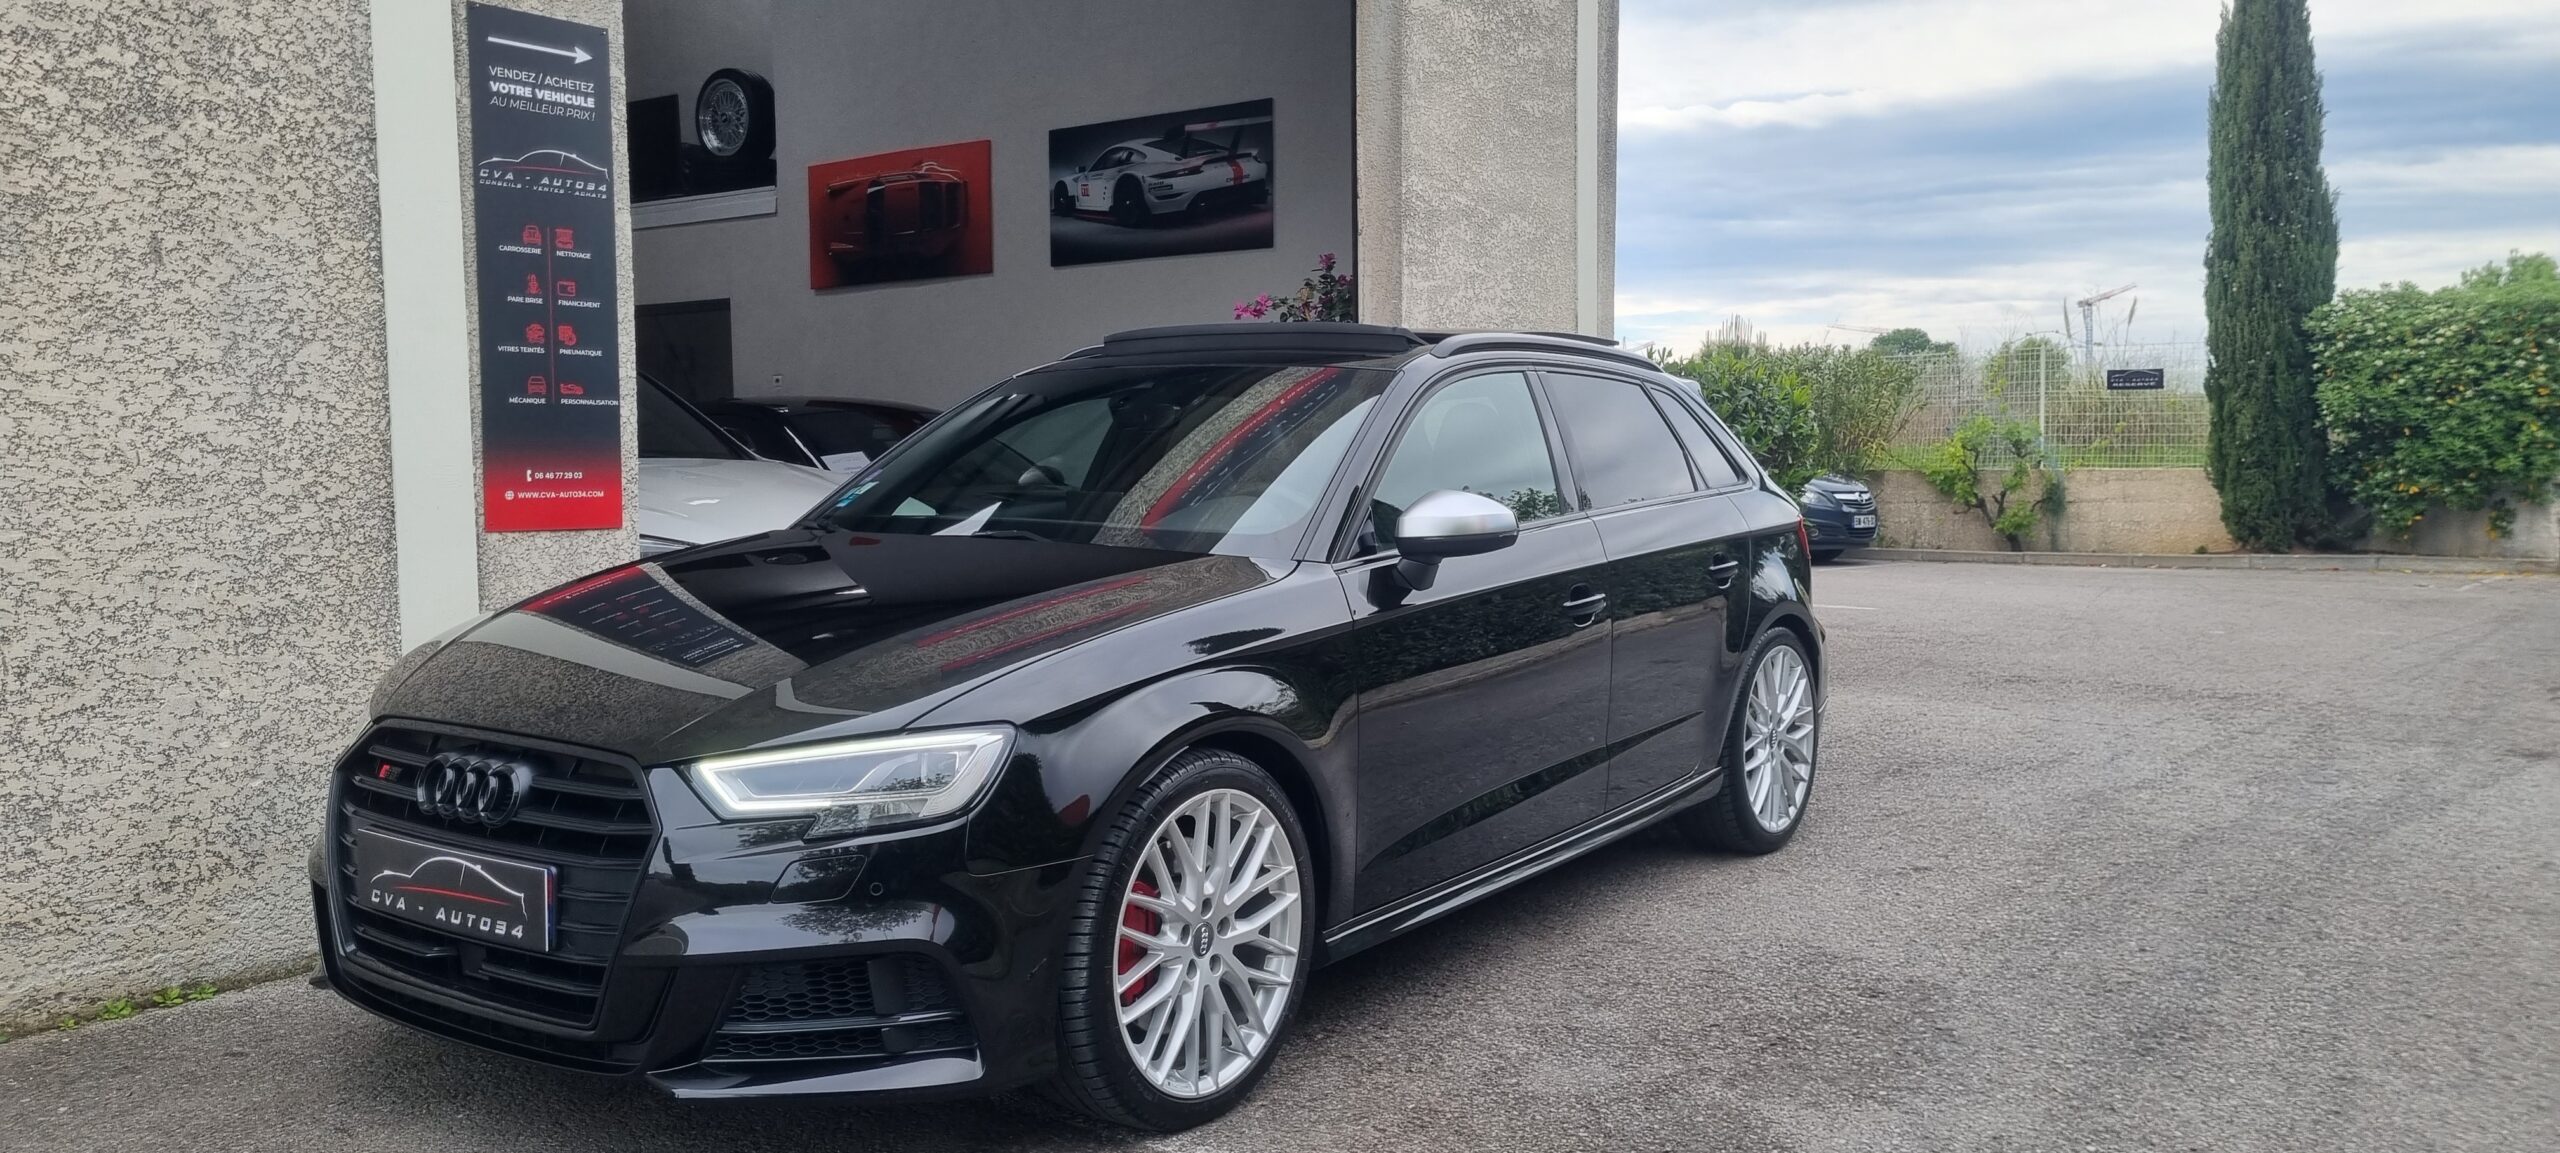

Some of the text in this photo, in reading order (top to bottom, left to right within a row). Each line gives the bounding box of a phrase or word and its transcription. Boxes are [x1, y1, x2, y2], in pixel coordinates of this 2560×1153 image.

[489, 65, 594, 93] VENDEZ / ACHETEZ
[490, 81, 595, 108] VOTRE VEHICULE
[490, 96, 507, 106] AU
[510, 99, 564, 116] MEILLEUR
[480, 169, 514, 180] CVA
[540, 176, 607, 192] AUTO34
[480, 179, 522, 188] CONSEILS
[533, 186, 565, 194] VENTES
[574, 191, 607, 199] ACHATS
[499, 245, 542, 255] CARROSSERIE
[556, 251, 592, 259] NETTOYAGE
[558, 300, 601, 308] FINANCEMENT
[560, 348, 602, 356] PNEUMATIQUE
[509, 396, 546, 404] MÉCANIQUE
[518, 491, 604, 499] WWW.CVA-AUTO34.COM
[371, 890, 406, 911] CVA
[436, 907, 523, 939] AUTO34
